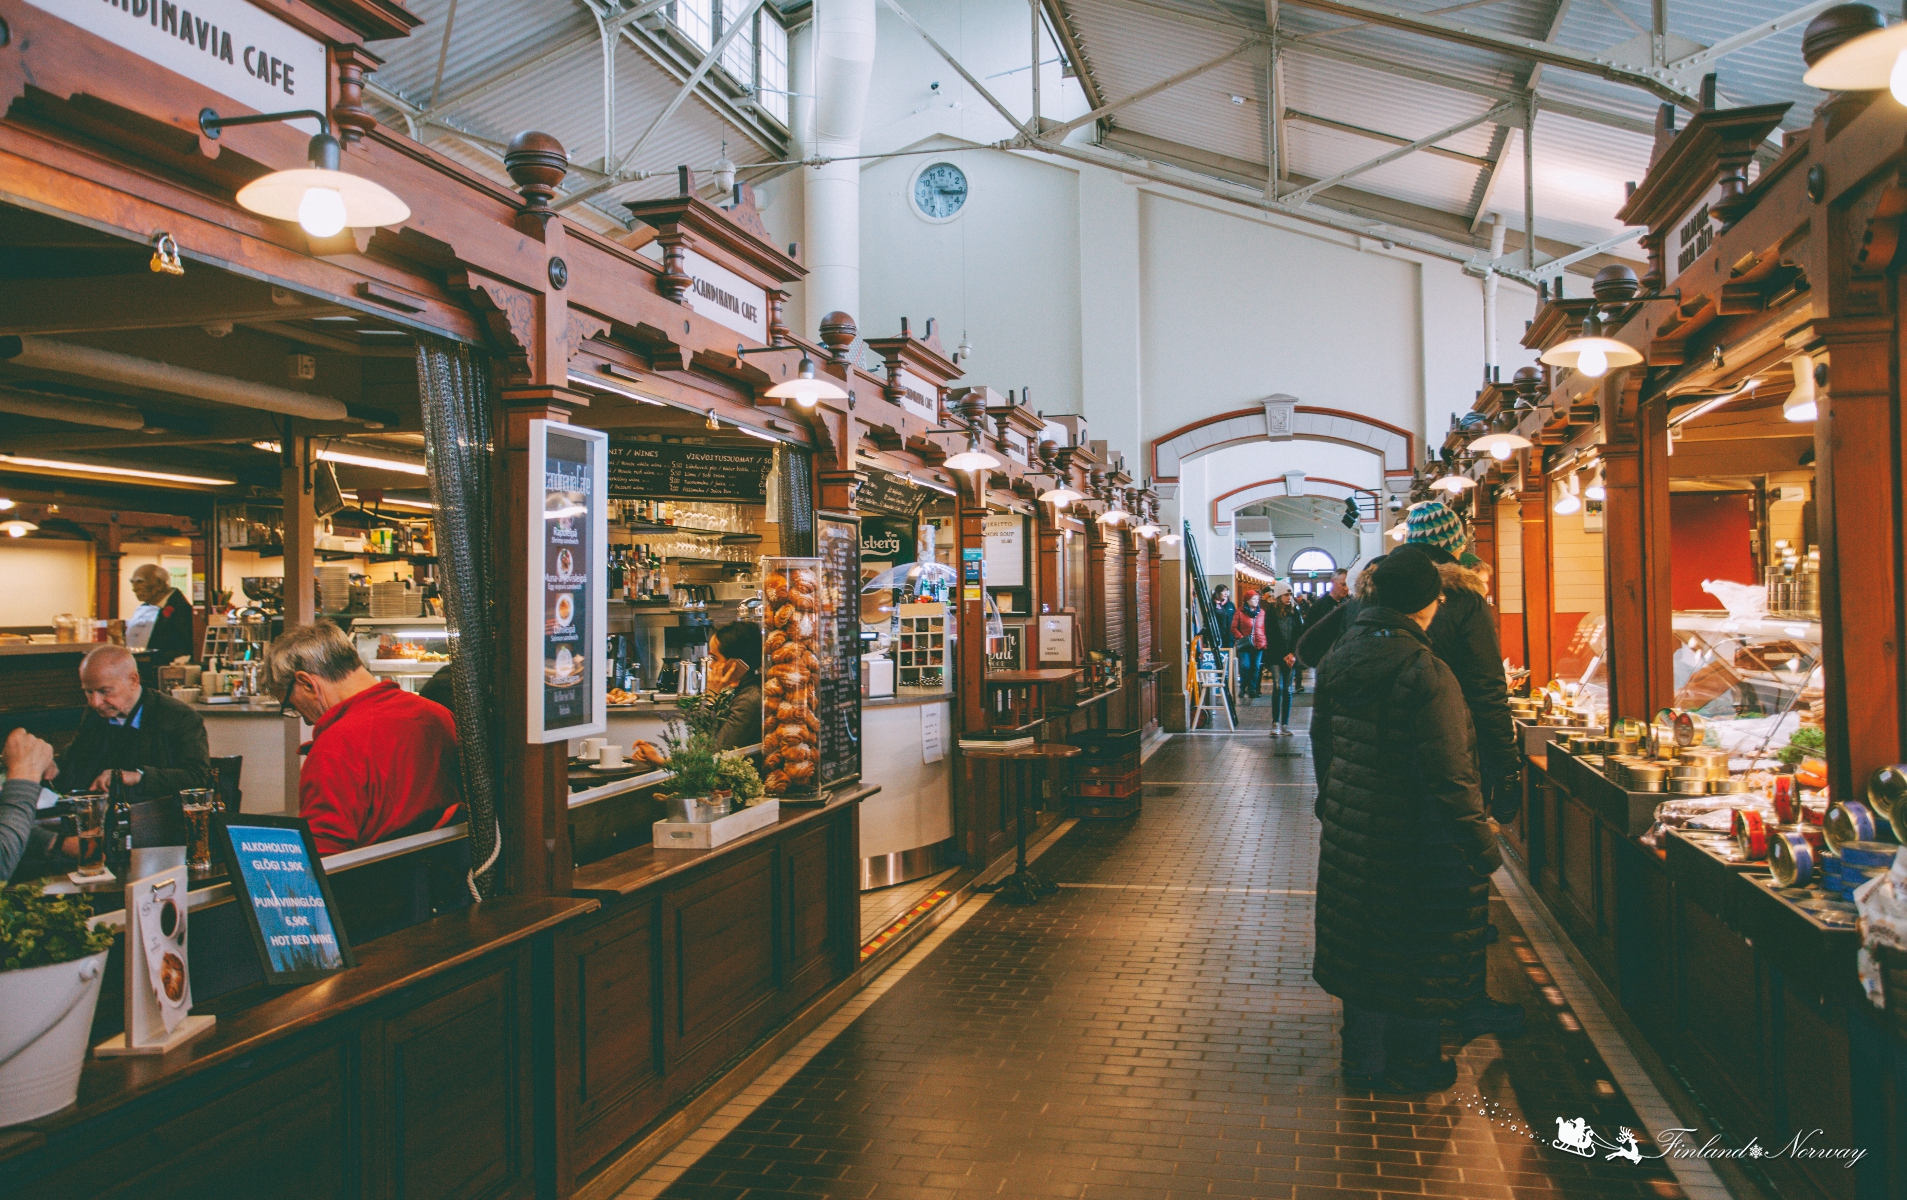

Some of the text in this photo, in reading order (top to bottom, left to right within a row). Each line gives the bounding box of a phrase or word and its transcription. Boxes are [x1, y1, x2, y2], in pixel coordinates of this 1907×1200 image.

[103, 0, 295, 96] DINAVIA CAFE
[692, 276, 758, 323] SCANDINAVIA CAFE
[860, 535, 900, 553] lsberg
[1203, 652, 1229, 663] STY
[242, 842, 302, 854] ALKOHOLITON
[252, 858, 280, 871] GLÖGI
[254, 896, 325, 908] PUNAVIINIGLÖGI
[270, 934, 333, 946] HOT RED WINE
